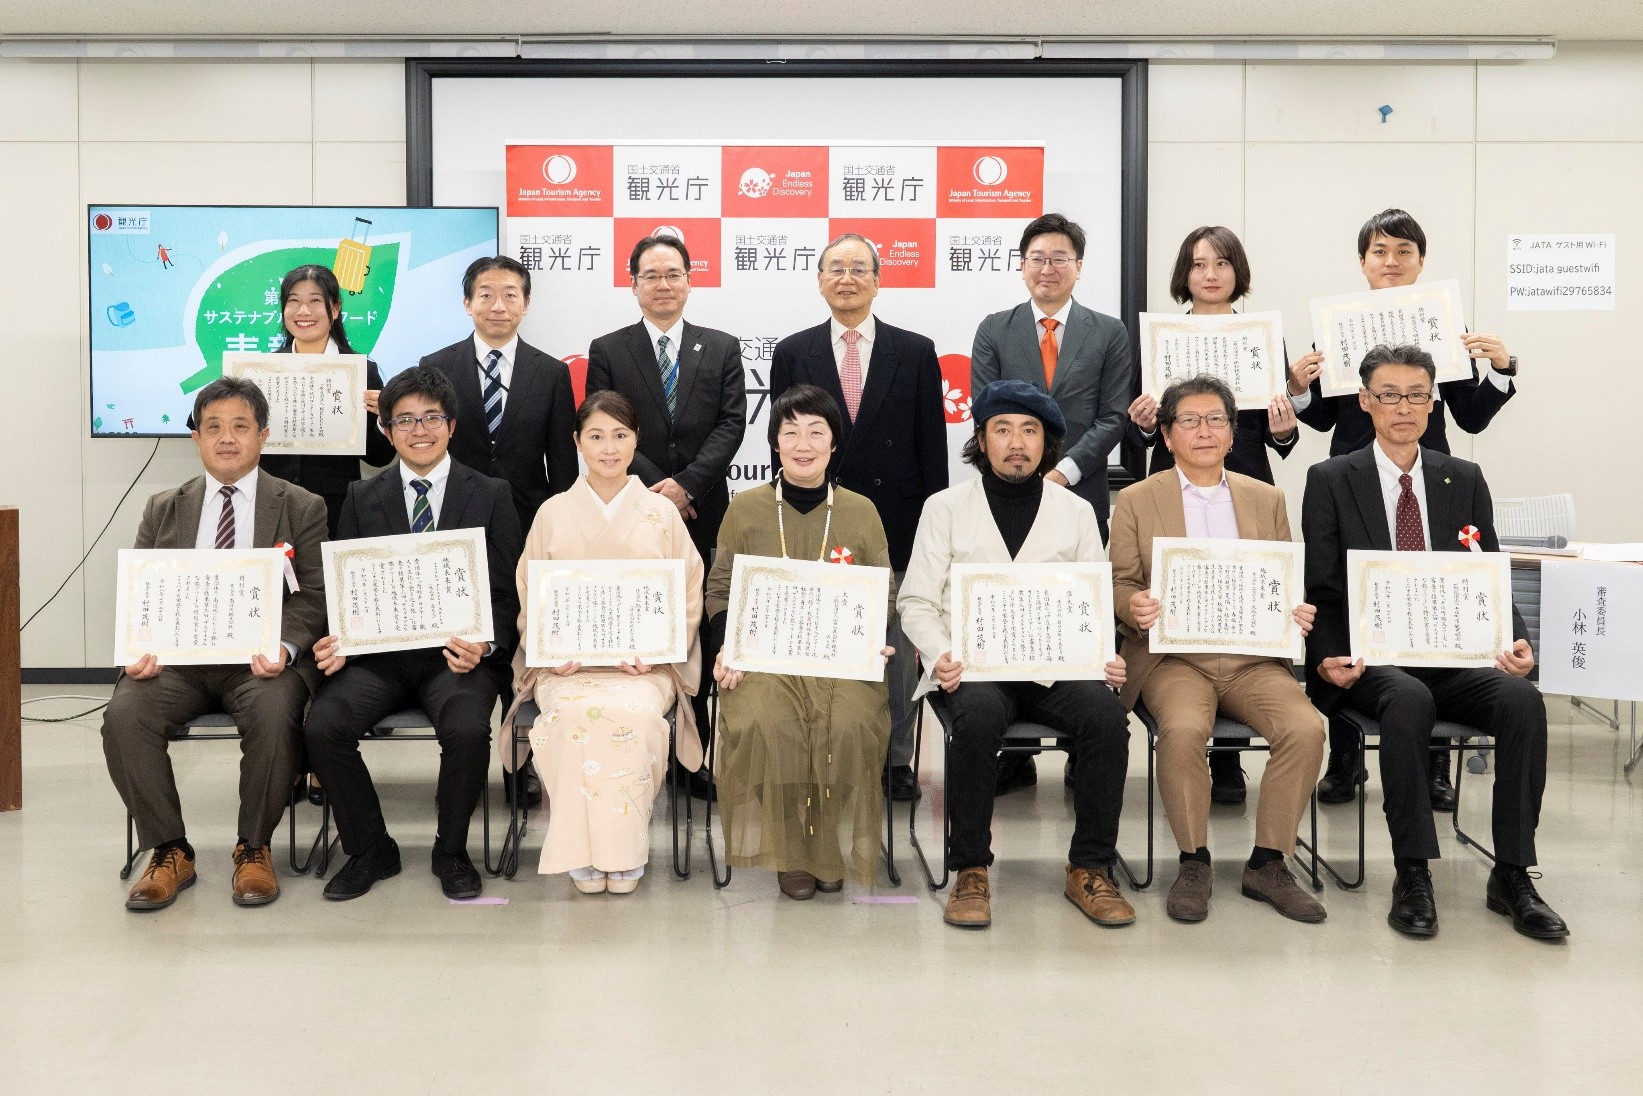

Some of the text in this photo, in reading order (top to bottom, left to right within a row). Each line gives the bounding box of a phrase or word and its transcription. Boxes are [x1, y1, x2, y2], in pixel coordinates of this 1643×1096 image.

[627, 164, 680, 175] 国土交通省
[785, 170, 811, 178] Japan
[843, 165, 896, 175] 国土交通省
[518, 188, 601, 198] Japan Tourism Agency
[627, 176, 709, 201] 観光庁
[772, 188, 812, 197] Discovery
[842, 177, 924, 201] 観光庁
[949, 189, 1031, 198] Japan Tourism Agency
[520, 234, 572, 245] 国土交通省
[735, 235, 788, 245] 国土交通省
[892, 240, 918, 249] Japan
[950, 235, 1002, 246] 国土交通省
[1530, 241, 1552, 249] JATA
[519, 246, 601, 271] 観光庁
[689, 260, 709, 268] ency
[735, 246, 816, 271] 観光庁
[879, 258, 919, 268] Discovery
[889, 250, 920, 258] Endless
[1427, 316, 1442, 343] 賞状
[1250, 346, 1263, 370] 賞状
[331, 389, 344, 415] 賞状
[727, 464, 771, 481] our
[454, 567, 470, 598] 賞状
[248, 586, 261, 618] 賞状
[652, 591, 665, 615] 賞状
[1267, 579, 1282, 613] 賞状
[1475, 592, 1490, 622] 賞状
[851, 604, 865, 636] 賞状
[1078, 601, 1093, 634] 賞状
[1571, 608, 1587, 670] 小林 英俊
